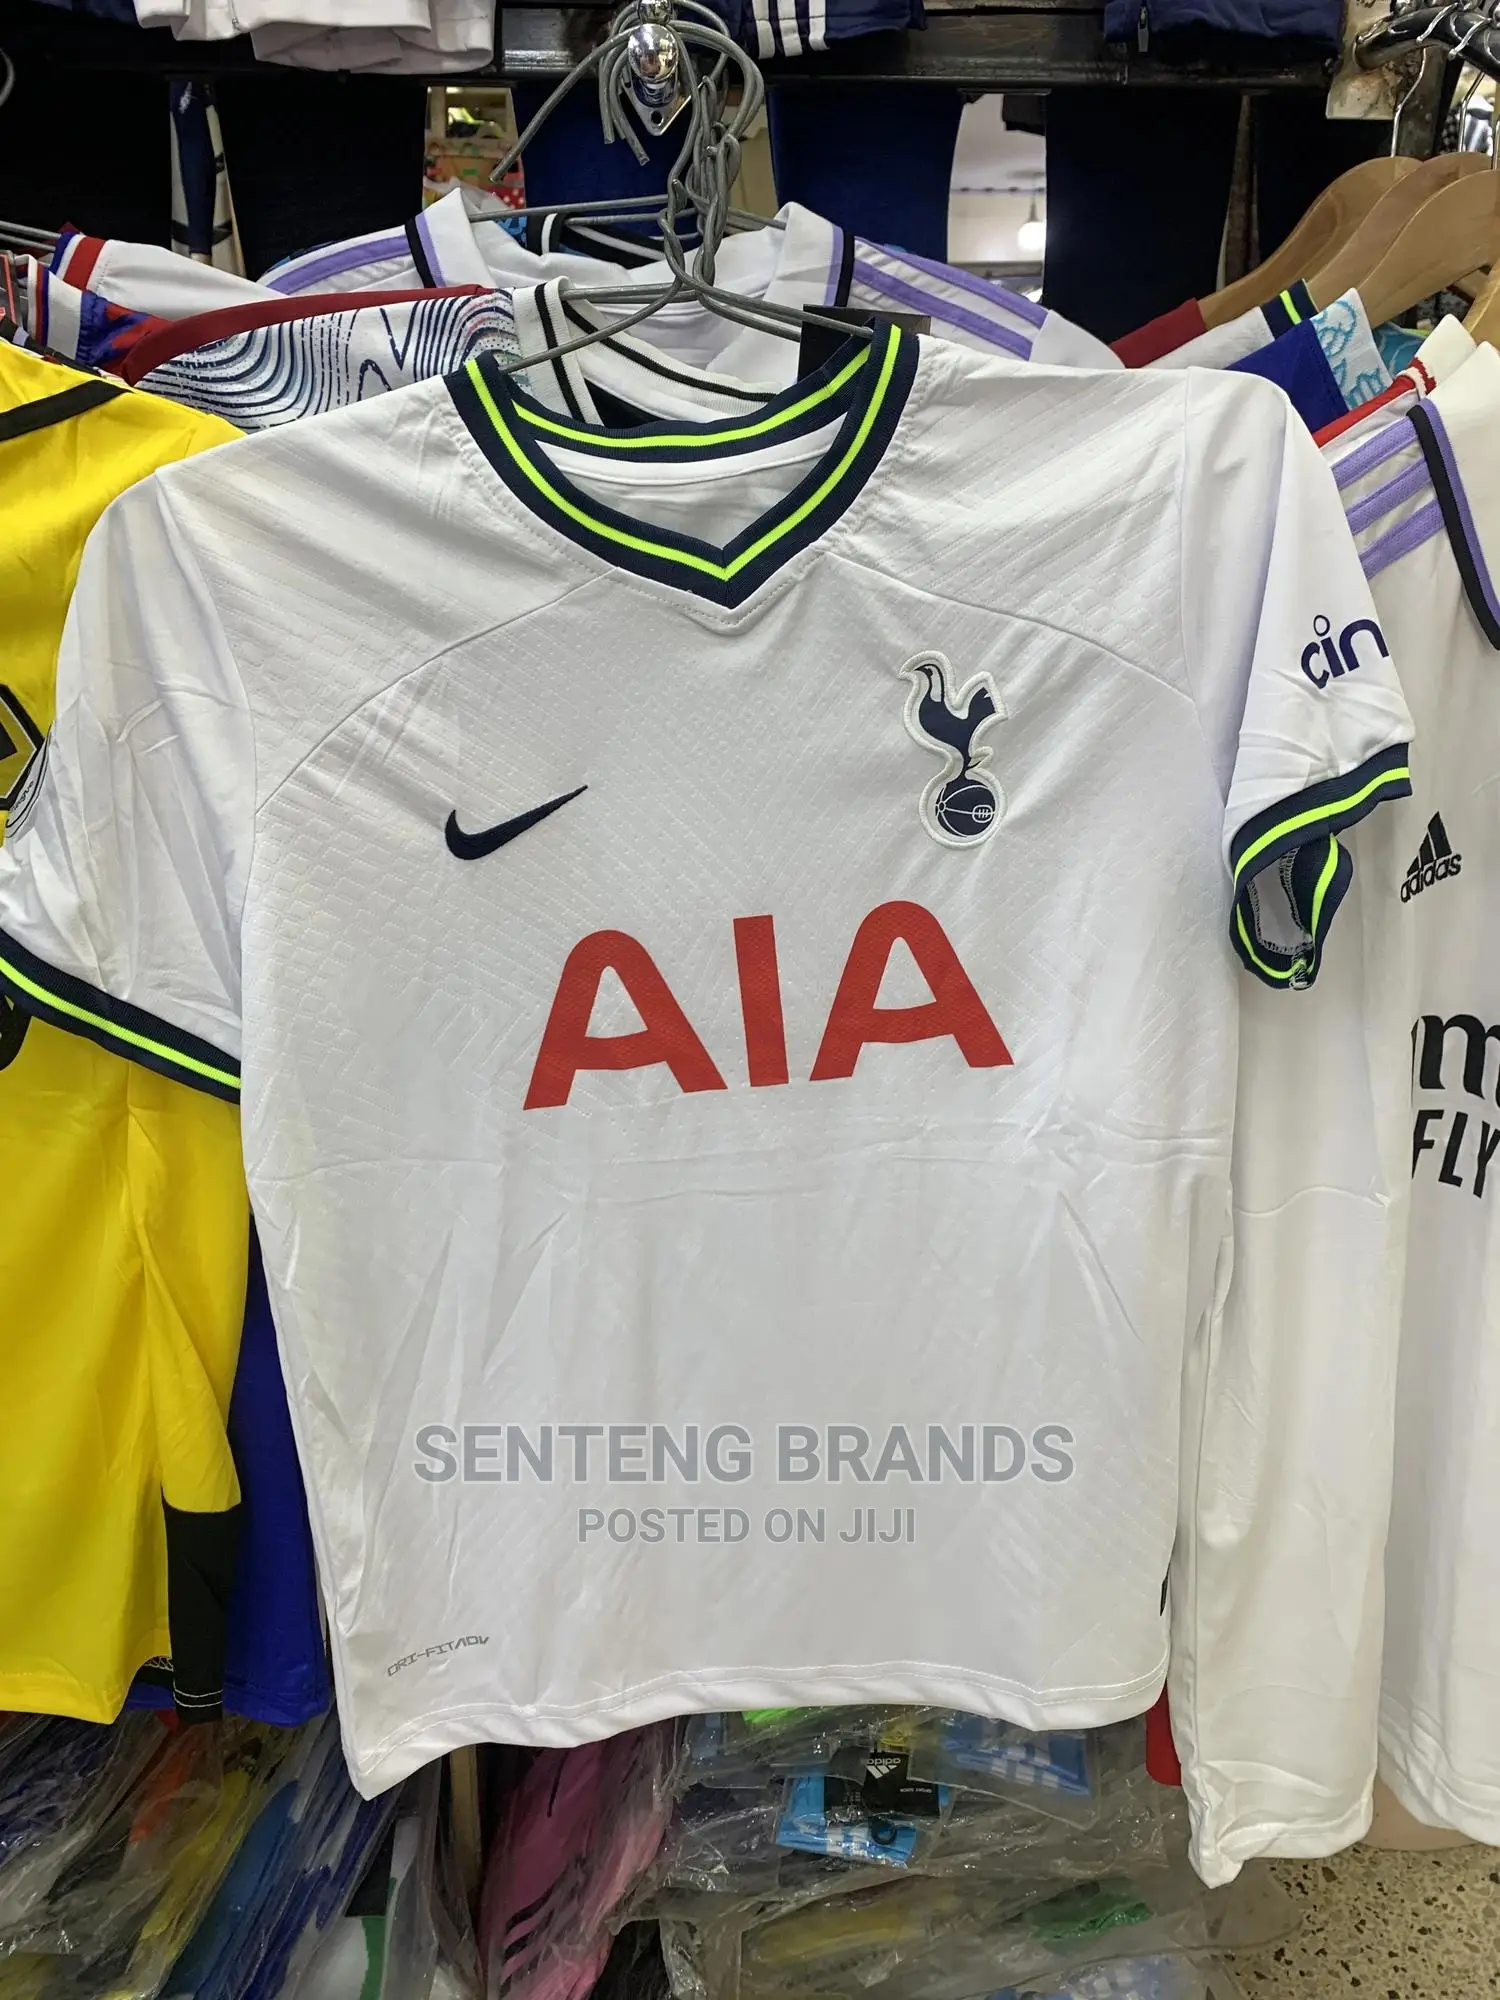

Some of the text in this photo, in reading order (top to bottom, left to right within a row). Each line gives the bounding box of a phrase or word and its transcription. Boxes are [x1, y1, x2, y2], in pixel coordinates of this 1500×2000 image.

[1301, 614, 1390, 690] cin
[1400, 853, 1463, 903] adidas
[523, 900, 1014, 1110] AIA
[1412, 1109, 1500, 1199] FLY
